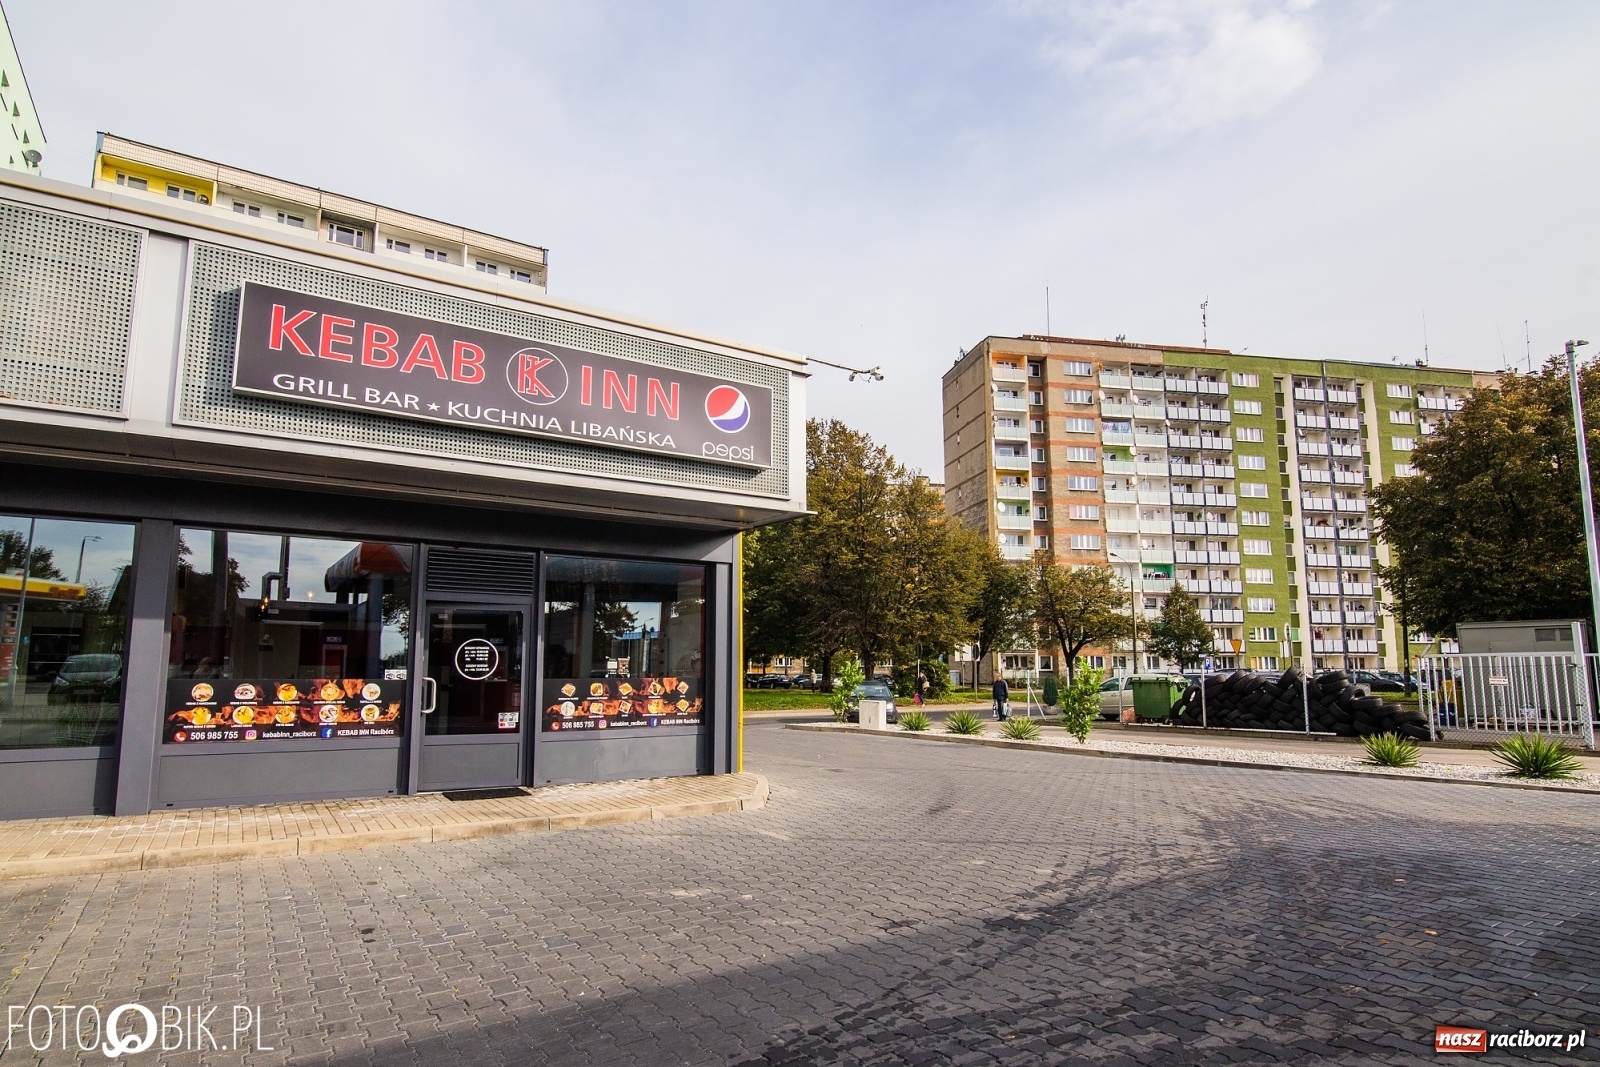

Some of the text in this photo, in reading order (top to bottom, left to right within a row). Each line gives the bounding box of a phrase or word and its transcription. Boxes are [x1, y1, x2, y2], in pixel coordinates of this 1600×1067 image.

[269, 303, 486, 385] KEBAB
[580, 365, 680, 421] INN
[272, 373, 677, 449] GRILL BAR KUCHNIA LIBAŃSKA
[702, 441, 755, 461] pepsi
[190, 730, 239, 740] 506 985 755
[370, 727, 395, 735] Racibórz
